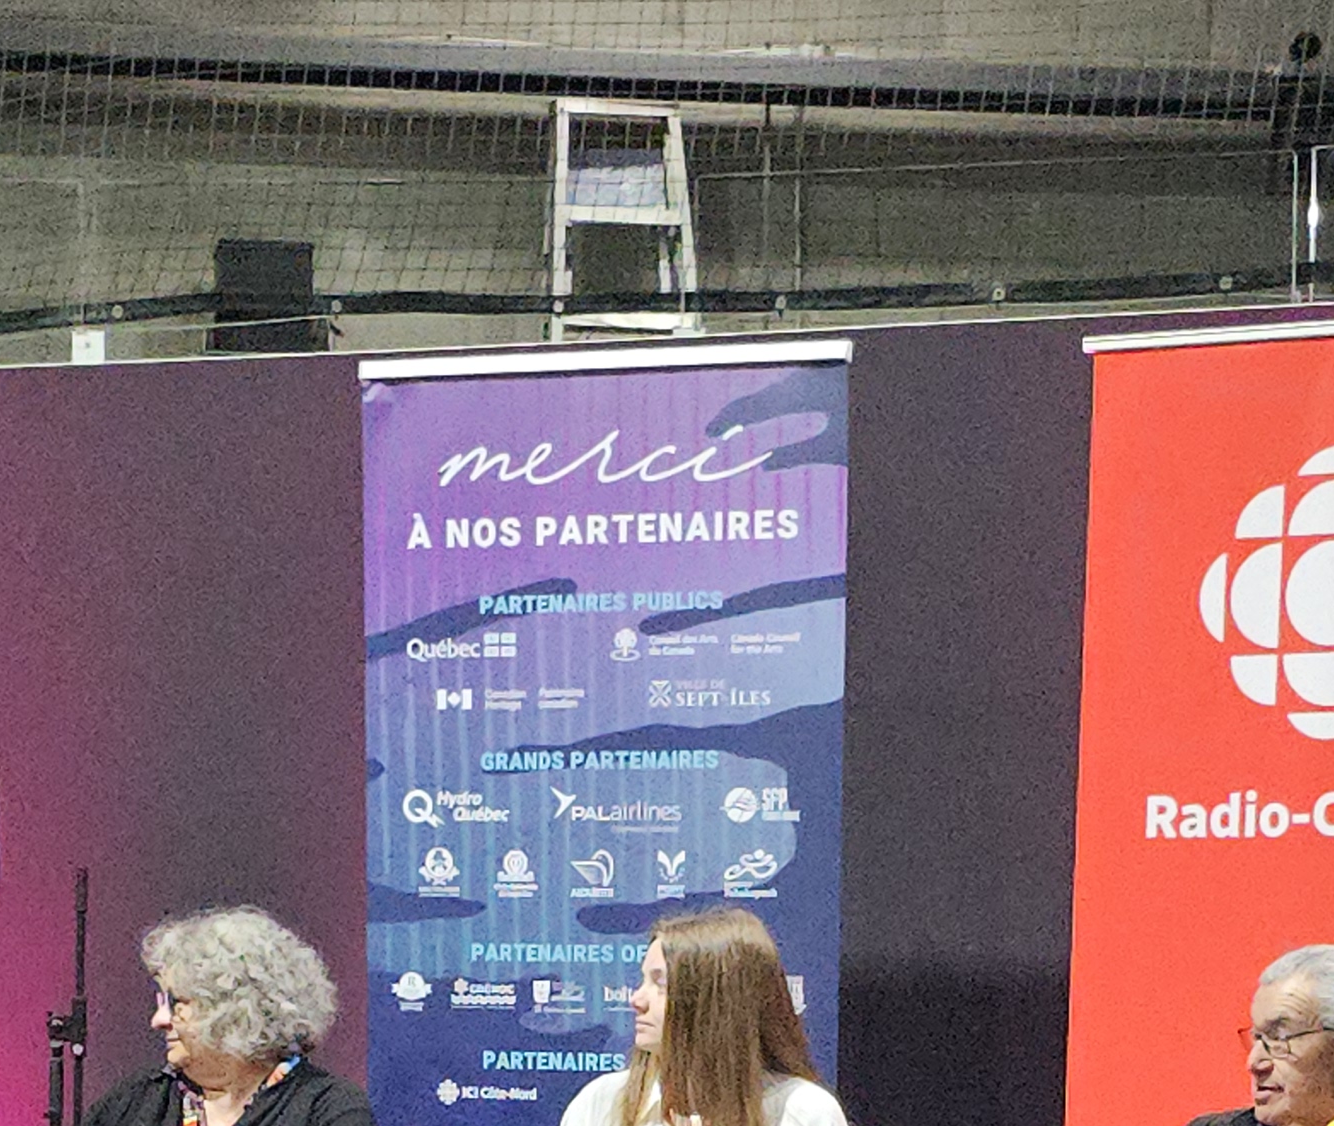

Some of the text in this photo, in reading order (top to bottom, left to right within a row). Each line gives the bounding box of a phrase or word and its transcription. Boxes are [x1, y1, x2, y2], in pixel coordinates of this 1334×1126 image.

[438, 425, 773, 487] merci
[407, 509, 799, 550] À NOS PARTENAIRES
[479, 591, 723, 615] PARTENAIRES PUBLICS
[406, 638, 481, 662] Québec
[480, 750, 719, 771] GRANDS PARTENAIRES
[436, 791, 483, 809] Hydro
[453, 805, 510, 822] Québec
[470, 943, 614, 963] PARTENAIRES
[483, 1051, 625, 1071] PARTENAIRES
